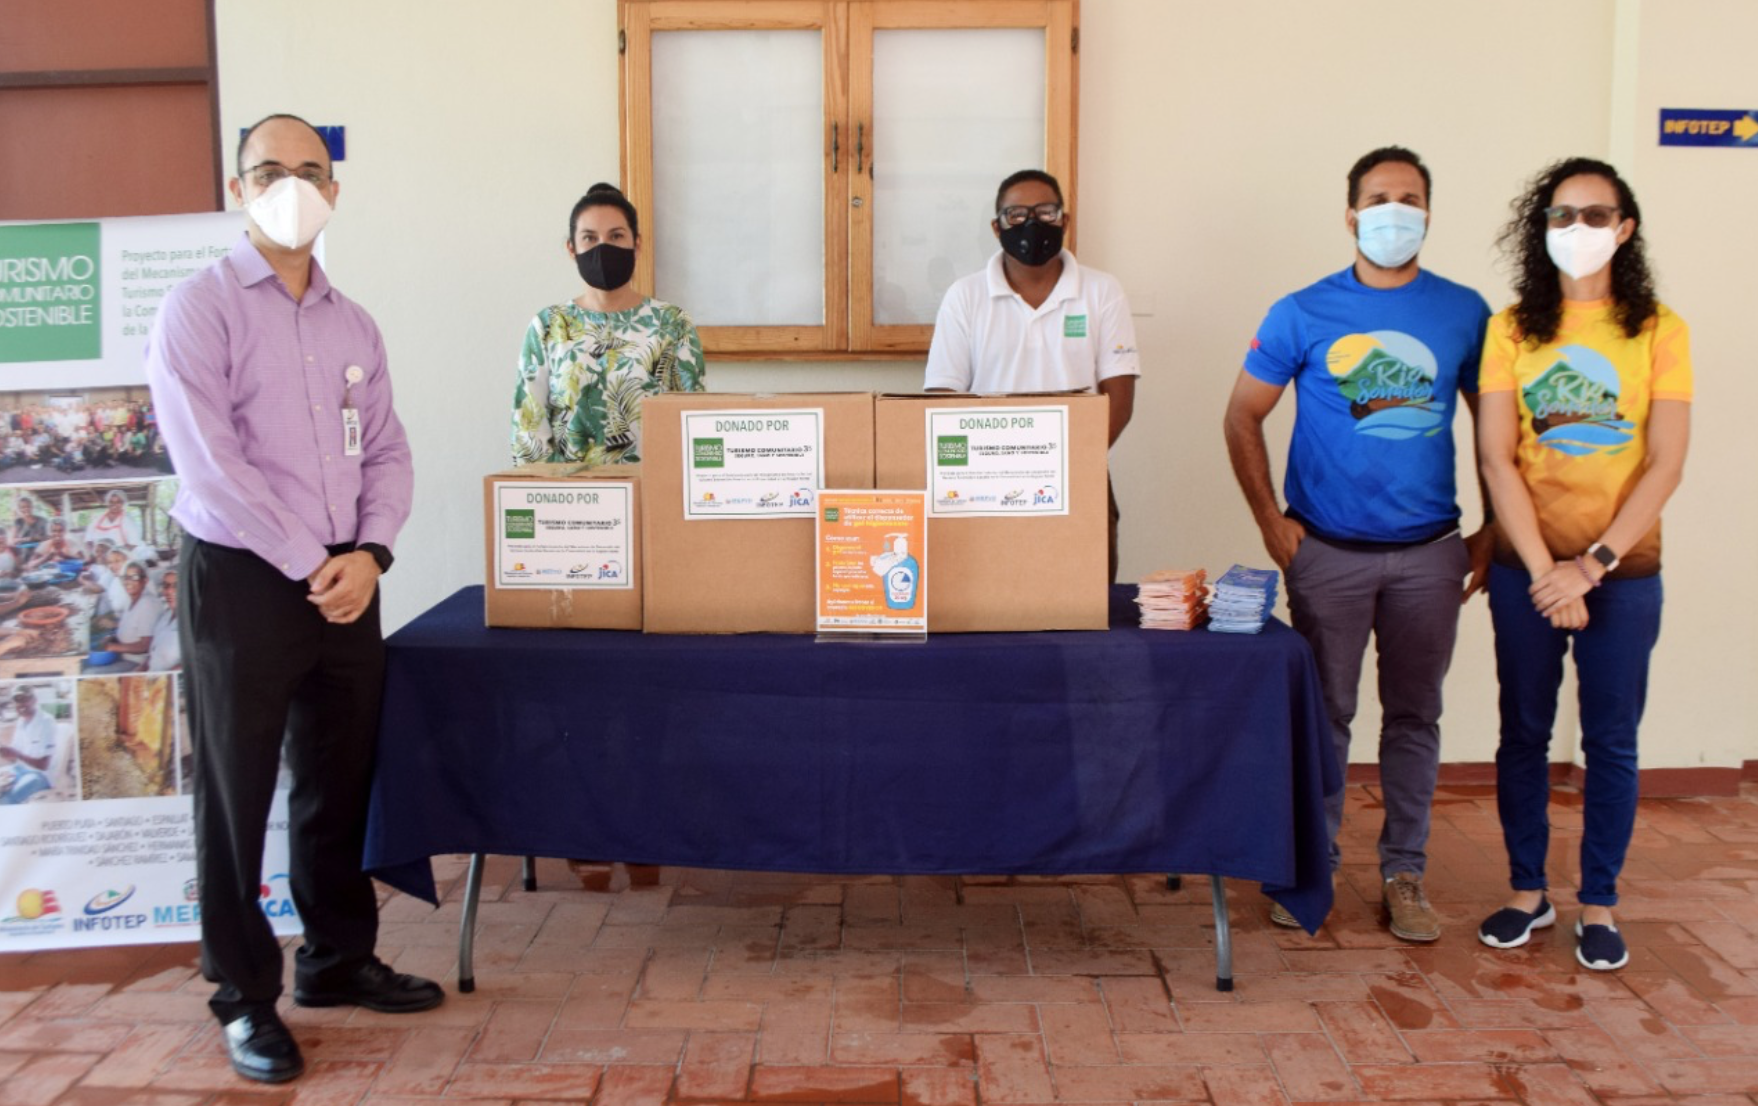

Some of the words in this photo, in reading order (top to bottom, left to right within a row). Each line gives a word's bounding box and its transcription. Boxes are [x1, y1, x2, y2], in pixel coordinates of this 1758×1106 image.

[1664, 119, 1731, 135] INFOTEP
[121, 249, 167, 265] Proyecto
[169, 249, 193, 263] para
[195, 246, 206, 259] el
[121, 267, 139, 280] del
[134, 304, 159, 318] Com
[716, 420, 763, 432] DONADO
[766, 419, 789, 431] POR
[960, 418, 1008, 430] DONADO
[1011, 417, 1034, 429] POR
[526, 493, 574, 504] DONADO
[576, 493, 599, 504] POR
[73, 914, 148, 932] INFOTEP
